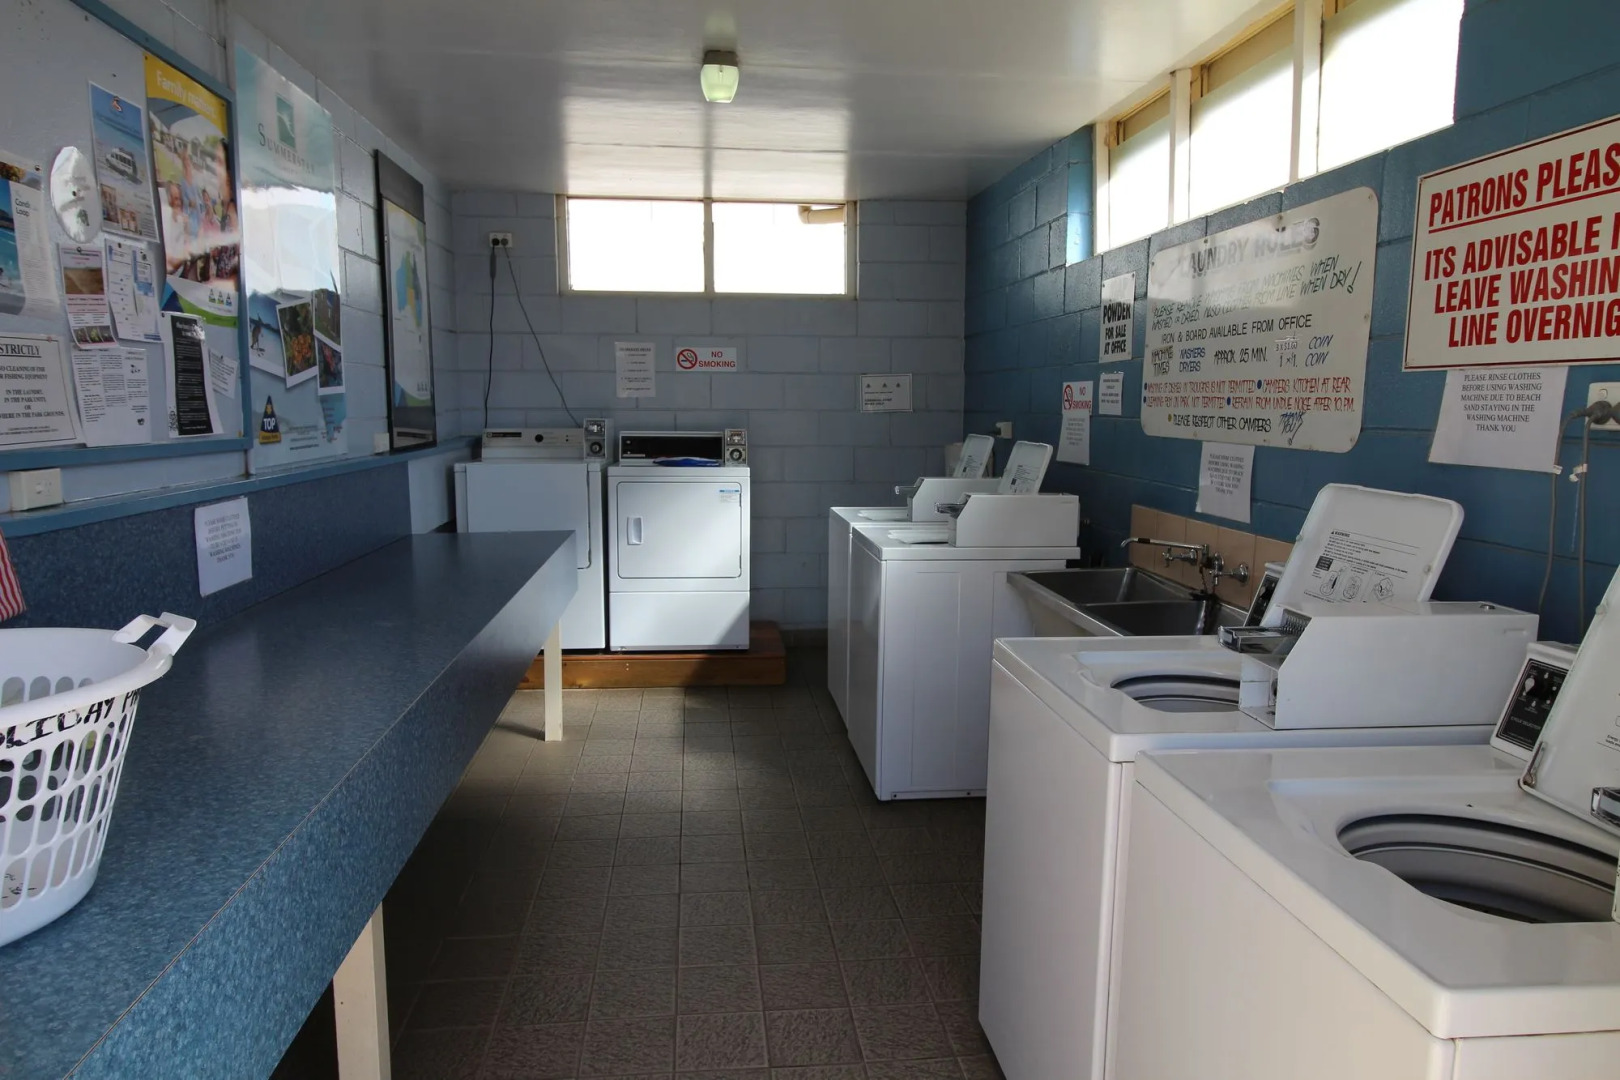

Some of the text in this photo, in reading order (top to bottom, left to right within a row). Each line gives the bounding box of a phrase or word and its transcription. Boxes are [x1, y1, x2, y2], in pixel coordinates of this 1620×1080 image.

[156, 69, 187, 103] Family
[1429, 142, 1620, 228] PATRONS PLEAS
[1425, 246, 1456, 281] ITS
[1462, 215, 1602, 274] ADVISABLE
[1310, 254, 1339, 276] WHEN
[1276, 281, 1297, 302] LINE
[1300, 275, 1328, 296] WHEN
[1435, 255, 1620, 314] LEAVE WASHIN
[1162, 314, 1312, 345] IRON & BOARD AVAILABLE FROM OFFICE
[1448, 298, 1620, 348] LINE OVERNIG
[1105, 324, 1127, 344] FOR SALE
[711, 351, 723, 359] NO
[1104, 339, 1127, 356] AT OFFICE
[1179, 348, 1206, 360] WASHERS
[1239, 349, 1249, 363] 25
[1309, 335, 1334, 350] COIN
[699, 360, 736, 369] SMOKING
[1153, 361, 1170, 377] TIMES
[1179, 361, 1201, 373] DRYERS
[1305, 352, 1330, 367] COIN
[1263, 379, 1289, 394] CAMPERS
[1292, 377, 1319, 393] KITCHEN
[1321, 378, 1329, 393] AT
[1332, 377, 1352, 393] REAR
[1464, 372, 1541, 382] PLEASE RINSE CLOTHES
[1079, 386, 1087, 396] NO
[1462, 383, 1542, 391] BEFORE USING WASHING
[1072, 400, 1092, 410] SMOKING
[1232, 397, 1253, 410] REFRAIN
[1256, 397, 1272, 410] FROM
[1295, 397, 1311, 411] NOISE
[1461, 394, 1541, 402] MACHINE DUE TO BEACH
[1463, 404, 1535, 412] SAND STAYING IN THE
[264, 417, 276, 431] TOP
[1173, 414, 1272, 433] PLEASE RESPECT OTHER CAMPERS
[1466, 414, 1530, 422] WASHING MACHINE
[1476, 424, 1516, 433] THANK YOU
[0, 697, 116, 749] LIDAY
